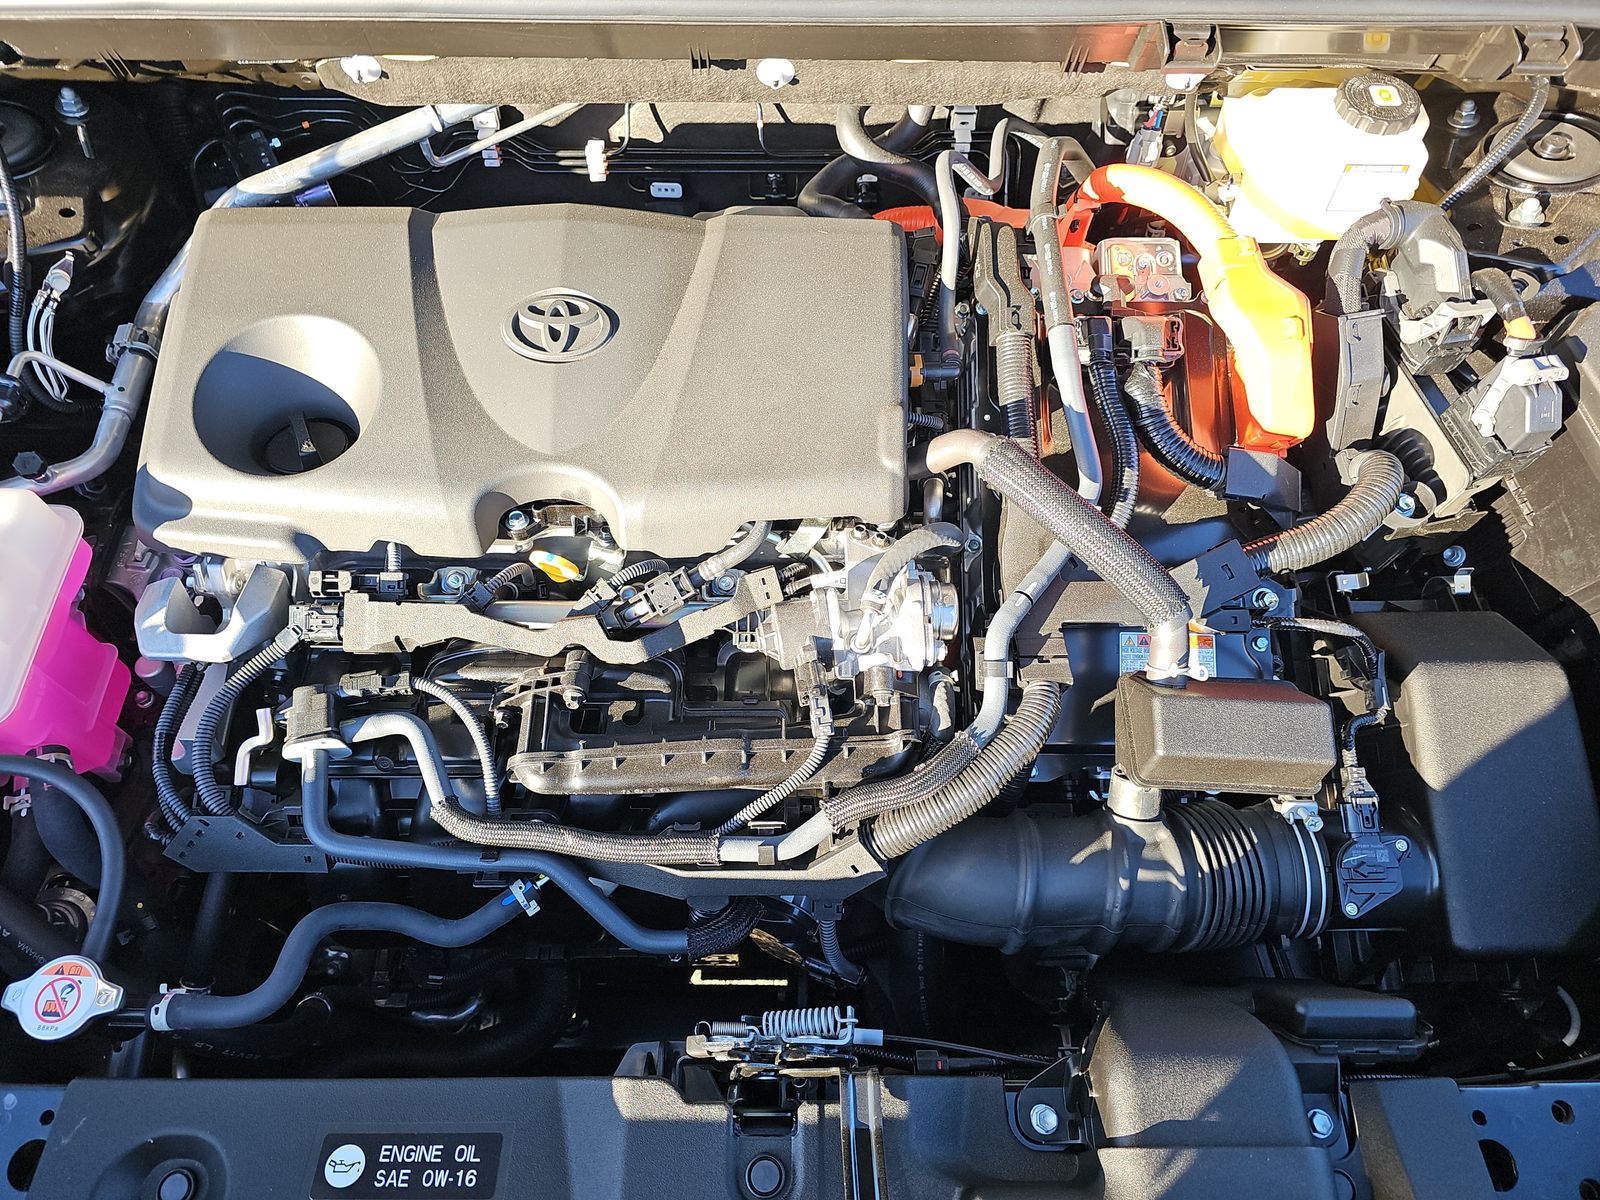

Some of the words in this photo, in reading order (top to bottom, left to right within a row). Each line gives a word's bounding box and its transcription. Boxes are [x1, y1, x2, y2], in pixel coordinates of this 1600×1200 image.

[379, 1145, 444, 1163] ENGINE
[454, 1145, 481, 1163] OIL
[374, 1169, 411, 1188] SAE
[422, 1169, 478, 1188] 0W-16
